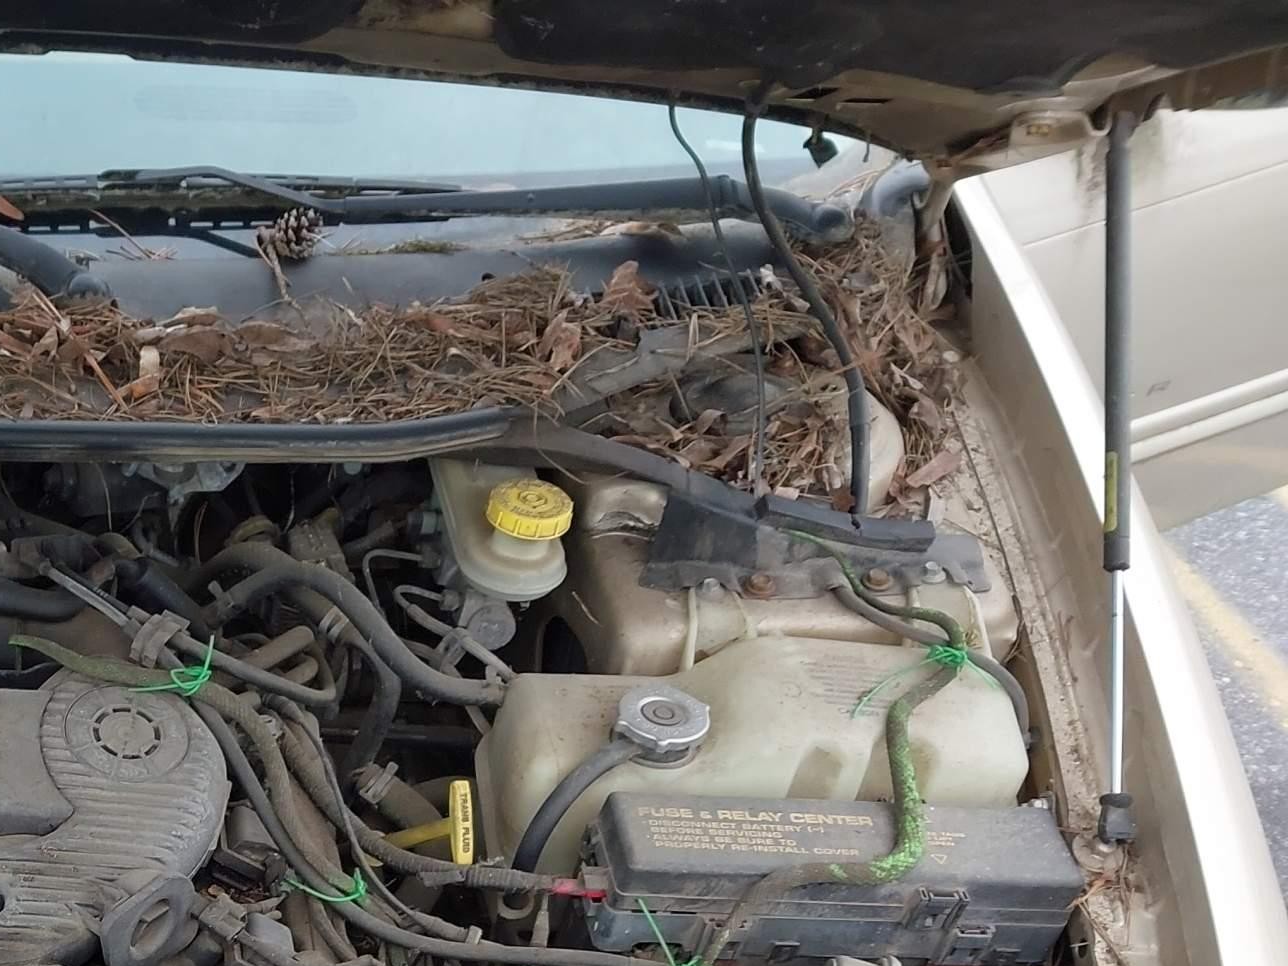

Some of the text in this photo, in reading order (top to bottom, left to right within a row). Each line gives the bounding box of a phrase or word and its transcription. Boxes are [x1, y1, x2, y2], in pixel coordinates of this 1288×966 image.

[638, 807, 873, 826] FUSE & RELAY CENTER
[648, 820, 738, 830] DISCONNECT
[742, 824, 802, 833] BATTERY
[650, 827, 783, 840] BEFORE SERVICING
[462, 827, 471, 853] FLUID
[714, 837, 735, 845] BE
[738, 838, 780, 846] SURE
[785, 839, 798, 847] TO
[655, 840, 859, 857] PROPERLY RE-INSTALL COVER
